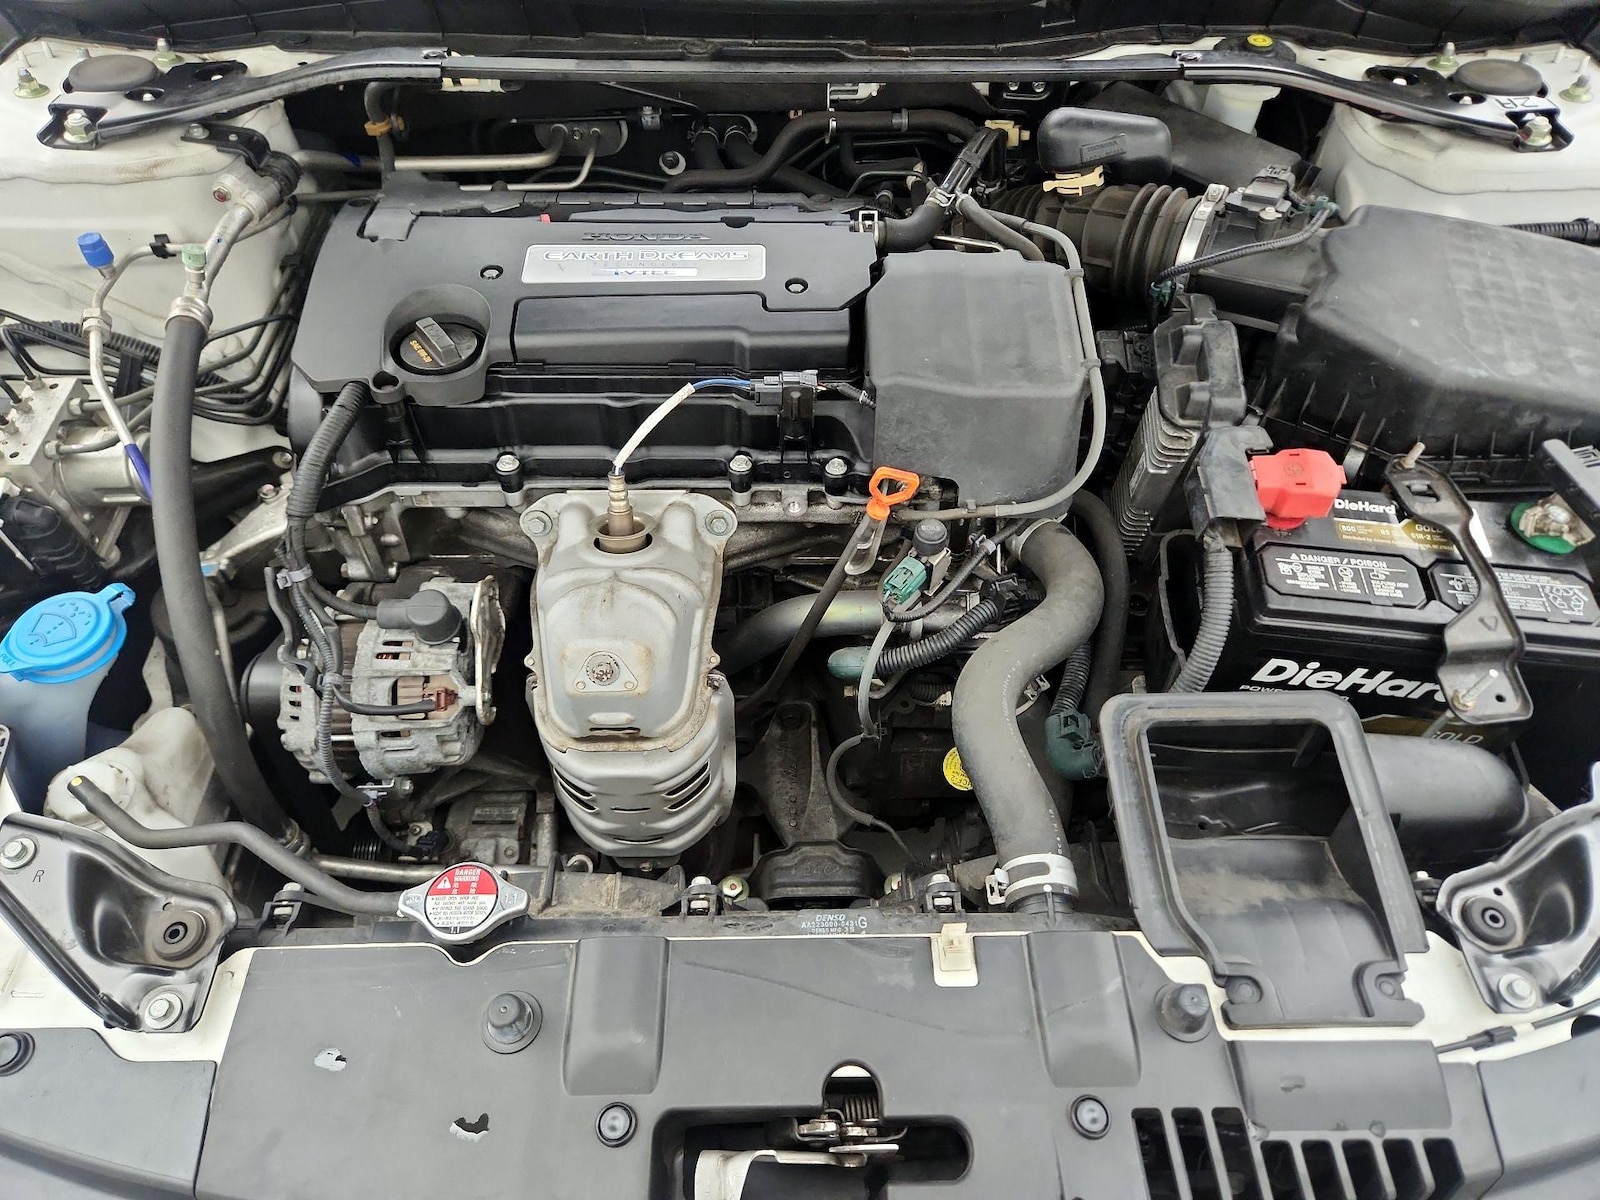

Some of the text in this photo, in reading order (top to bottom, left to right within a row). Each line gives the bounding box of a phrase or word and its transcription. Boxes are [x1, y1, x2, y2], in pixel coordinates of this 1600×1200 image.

[581, 232, 711, 242] HONDA
[543, 249, 749, 261] EARTH DREAMS
[1334, 499, 1396, 514] DieHard
[1300, 553, 1341, 564] DANGER
[1350, 558, 1388, 569] POISON
[32, 869, 45, 883] R
[455, 868, 481, 876] DANGER
[815, 914, 846, 922] DENSO
[858, 916, 868, 929] G
